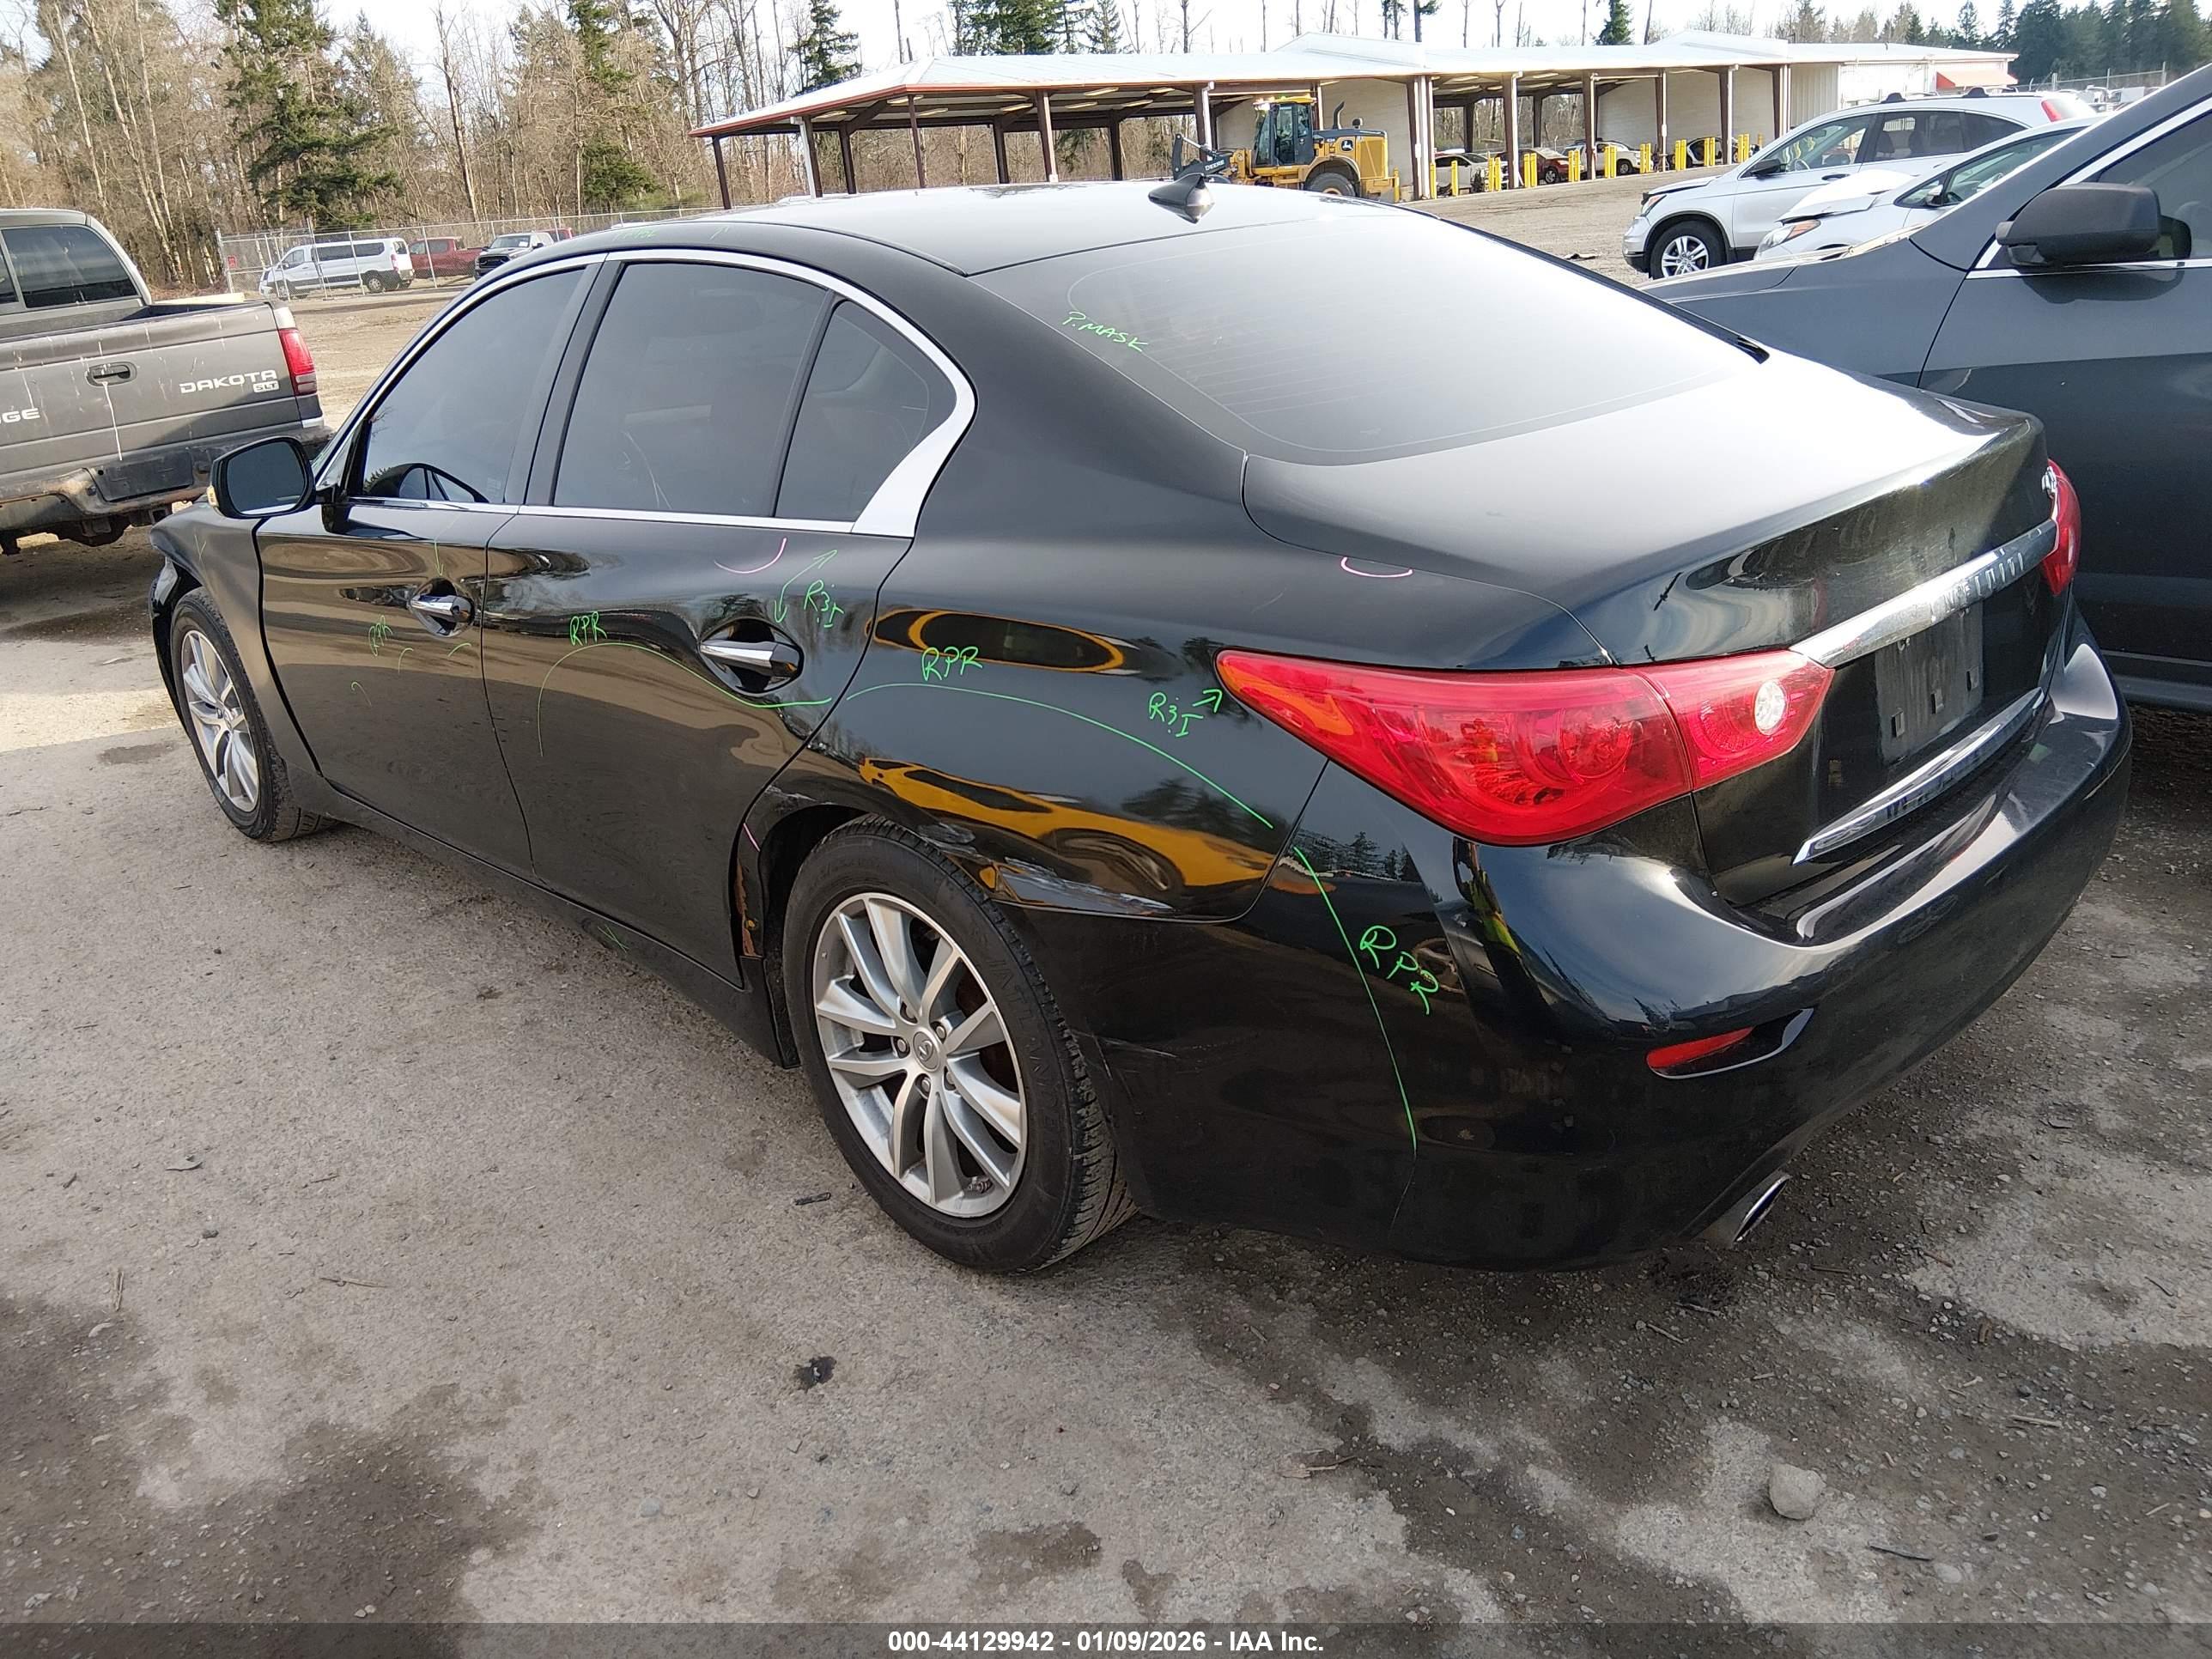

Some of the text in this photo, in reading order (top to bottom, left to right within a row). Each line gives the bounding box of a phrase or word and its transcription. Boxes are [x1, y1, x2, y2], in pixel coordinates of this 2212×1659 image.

[1205, 160, 1224, 171] DEERE
[179, 369, 277, 394] DAKOTA
[253, 380, 279, 392] SLT
[0, 407, 40, 423] GE
[569, 611, 608, 646] RPR
[921, 646, 983, 682] RPR
[1359, 924, 1440, 1015] RPR
